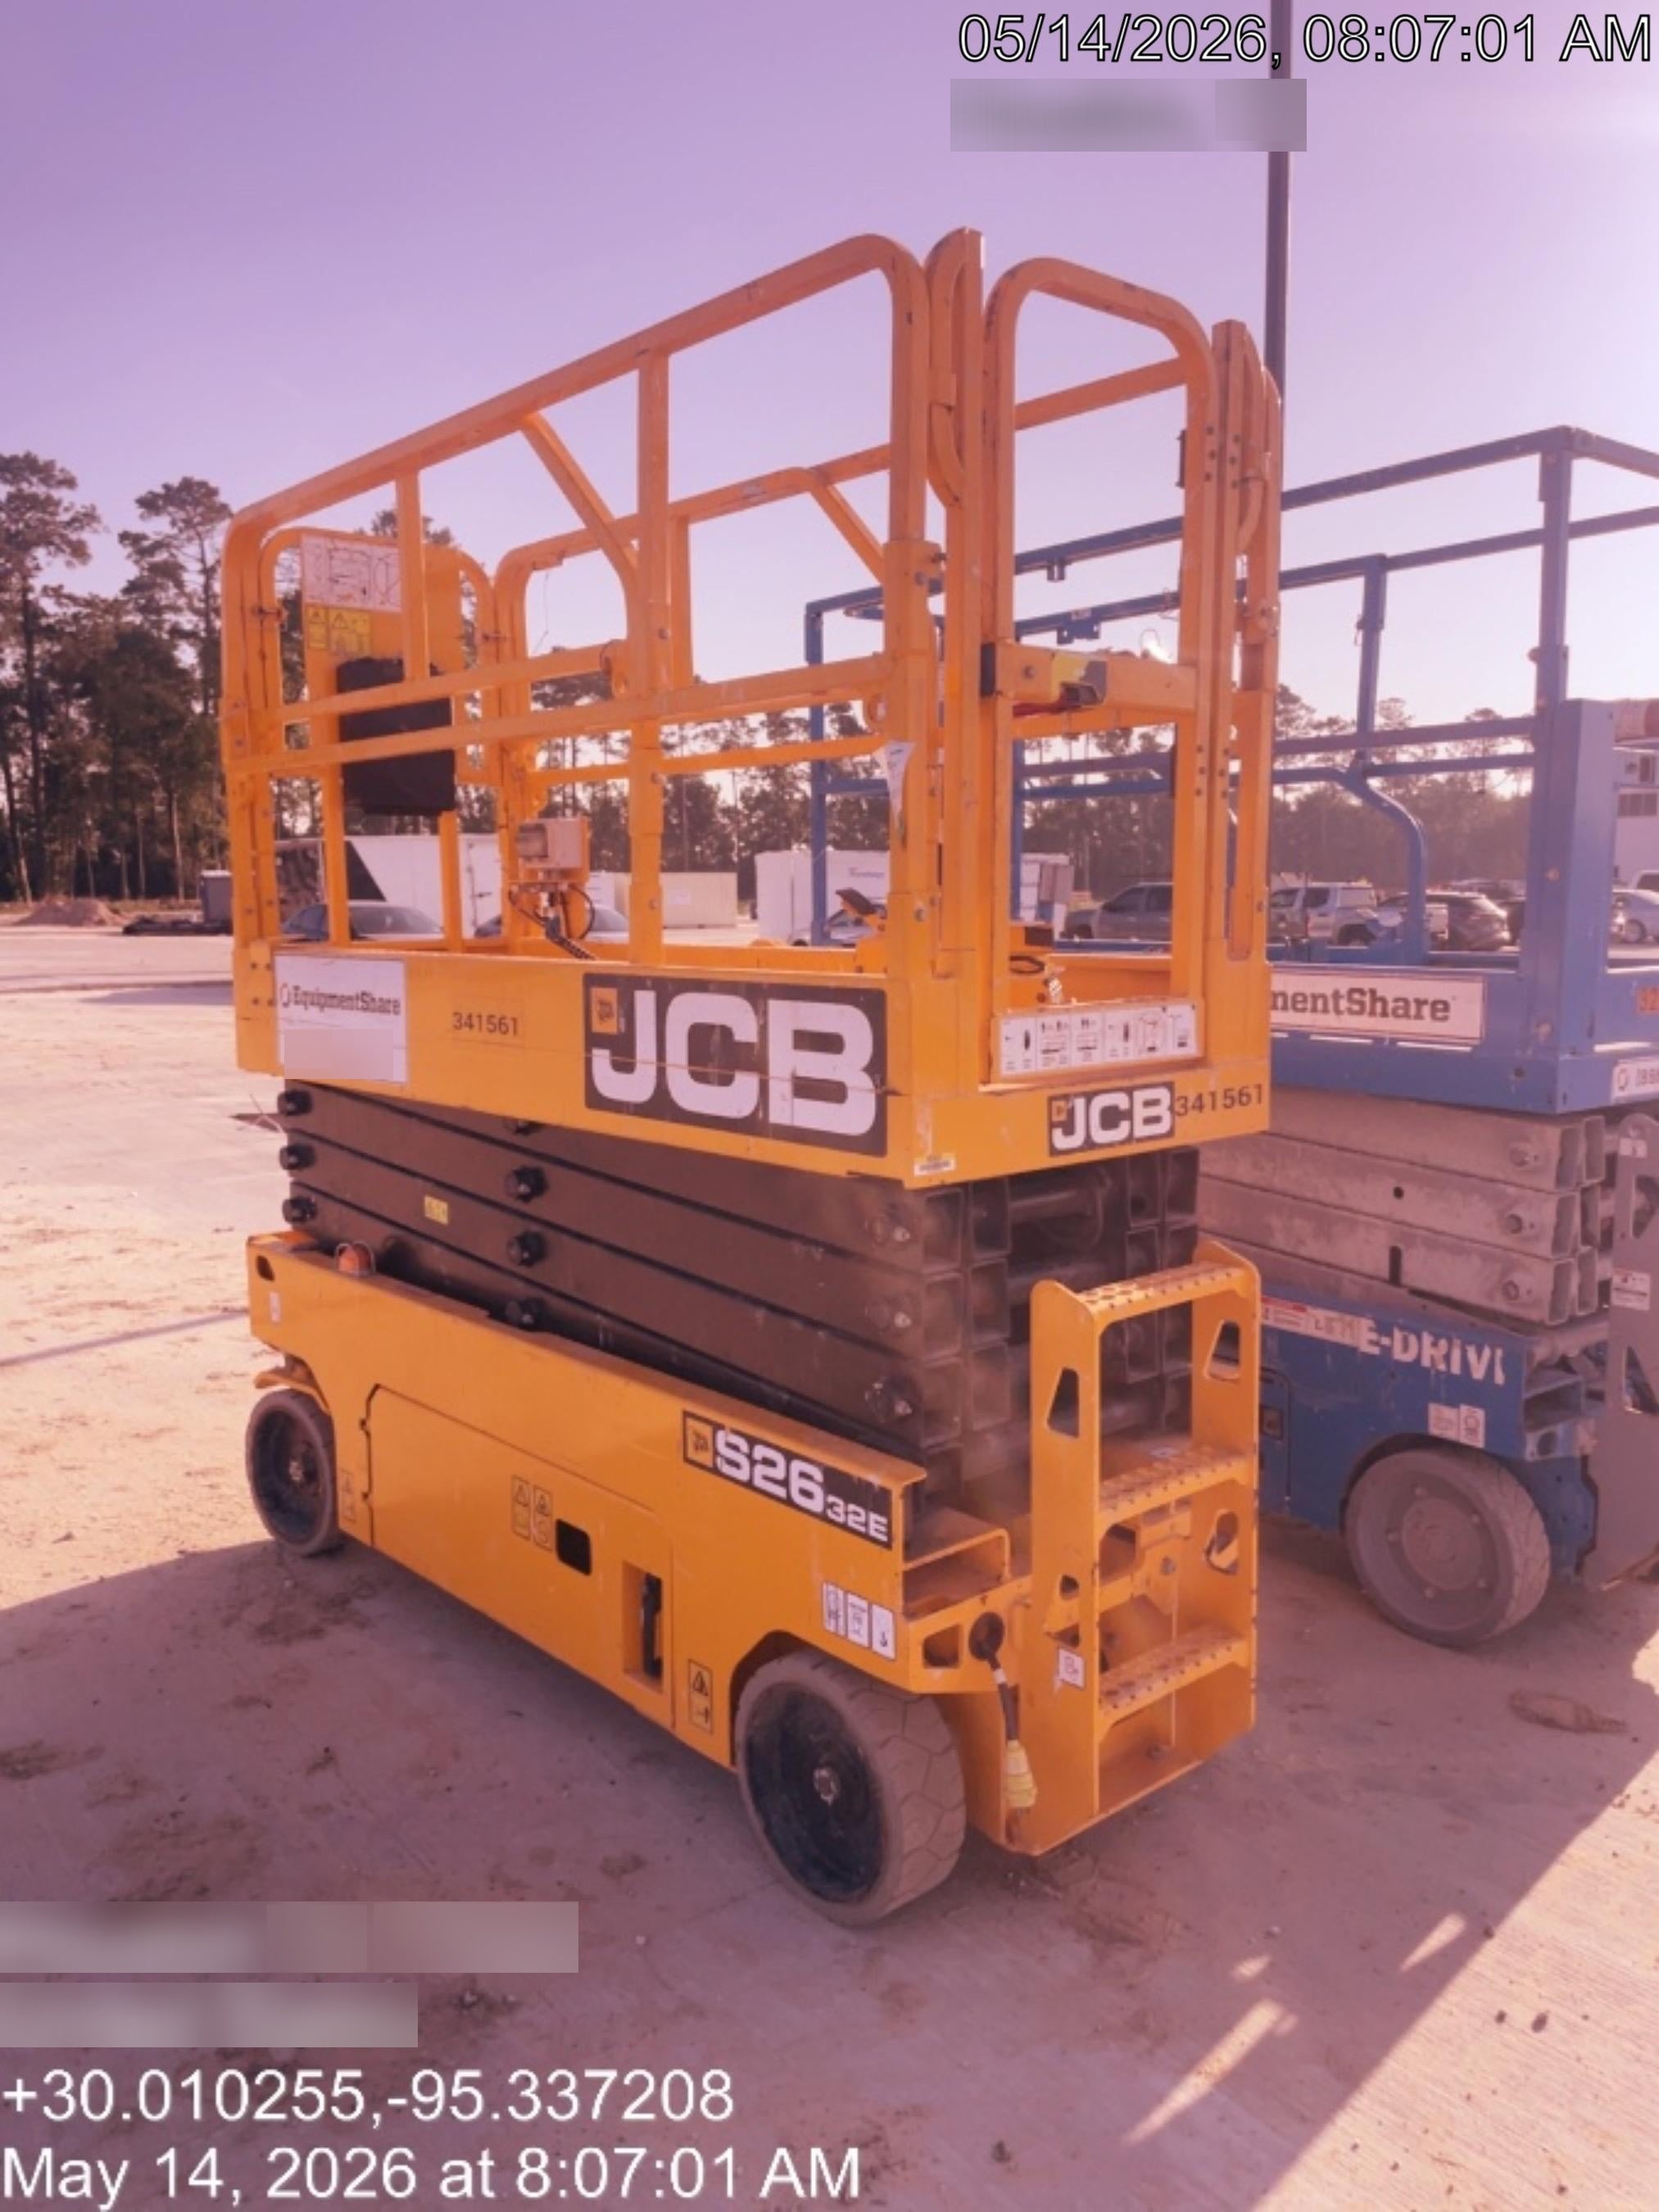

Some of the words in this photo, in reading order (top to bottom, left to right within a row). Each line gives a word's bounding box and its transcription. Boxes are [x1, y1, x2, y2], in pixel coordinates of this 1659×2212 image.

[292, 985, 401, 1016] EquipmentShare
[452, 1012, 519, 1036] 341561
[591, 989, 877, 1137] JCB
[1175, 1083, 1262, 1117] 341561
[1052, 1086, 1172, 1151] JCB
